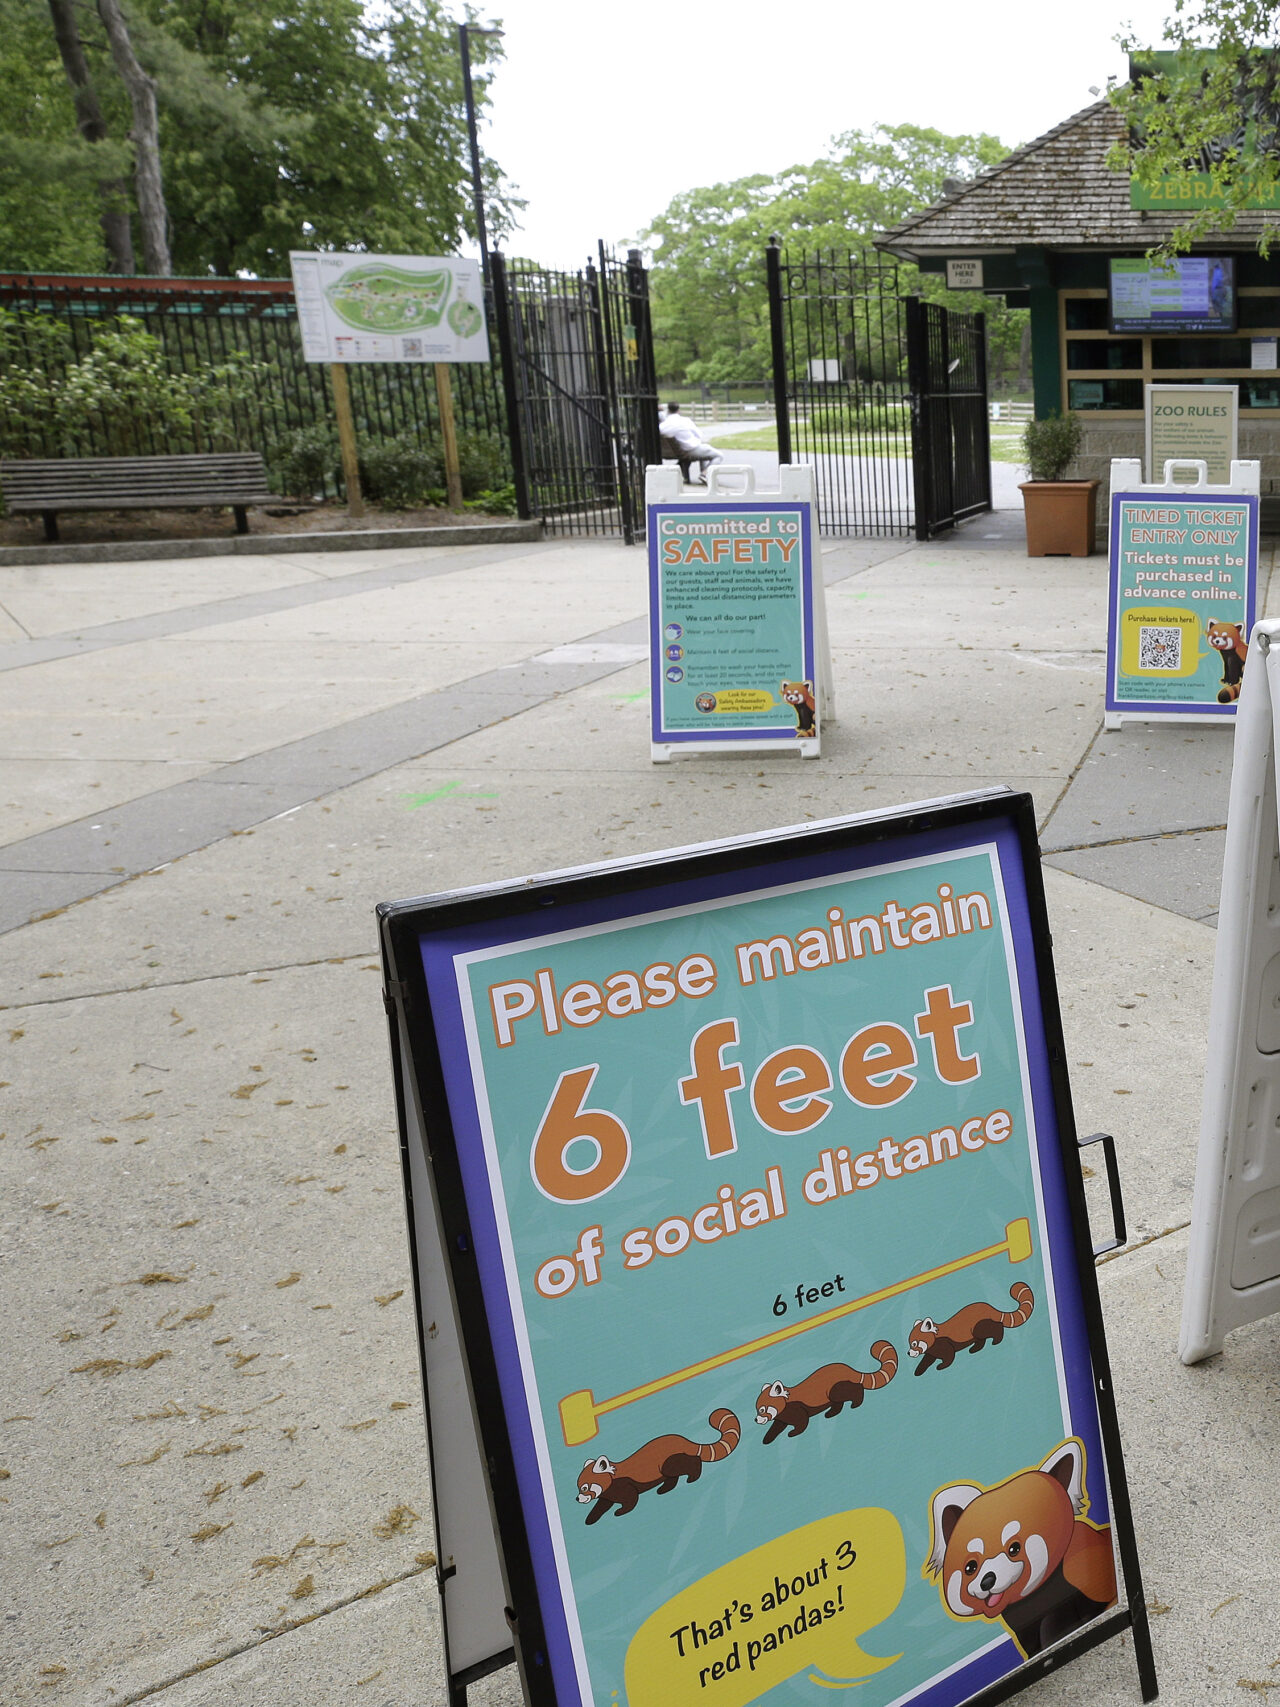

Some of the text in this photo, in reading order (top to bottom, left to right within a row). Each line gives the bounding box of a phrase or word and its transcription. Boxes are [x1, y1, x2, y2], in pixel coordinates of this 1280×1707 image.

[1150, 181, 1225, 200] ZEBRA
[1154, 406, 1227, 417] ZOO RULES
[1125, 509, 1245, 525] TIMED TICKET
[661, 519, 798, 534] Committed to
[1131, 528, 1239, 545] ENTRY ONLY
[663, 538, 797, 564] SAFETY
[1124, 551, 1244, 567] Tickets must be
[1136, 570, 1232, 584] purchased in
[1123, 586, 1242, 600] advance online.
[1127, 614, 1157, 622] Purchase
[1179, 615, 1195, 623] here!
[490, 883, 993, 1048] Please maintain
[531, 984, 981, 1204] 6 feet
[535, 1110, 1014, 1299] of social distance
[773, 1274, 845, 1316] 6 feet
[669, 1540, 856, 1656] That's about 3
[699, 1584, 844, 1687] red pandas!
